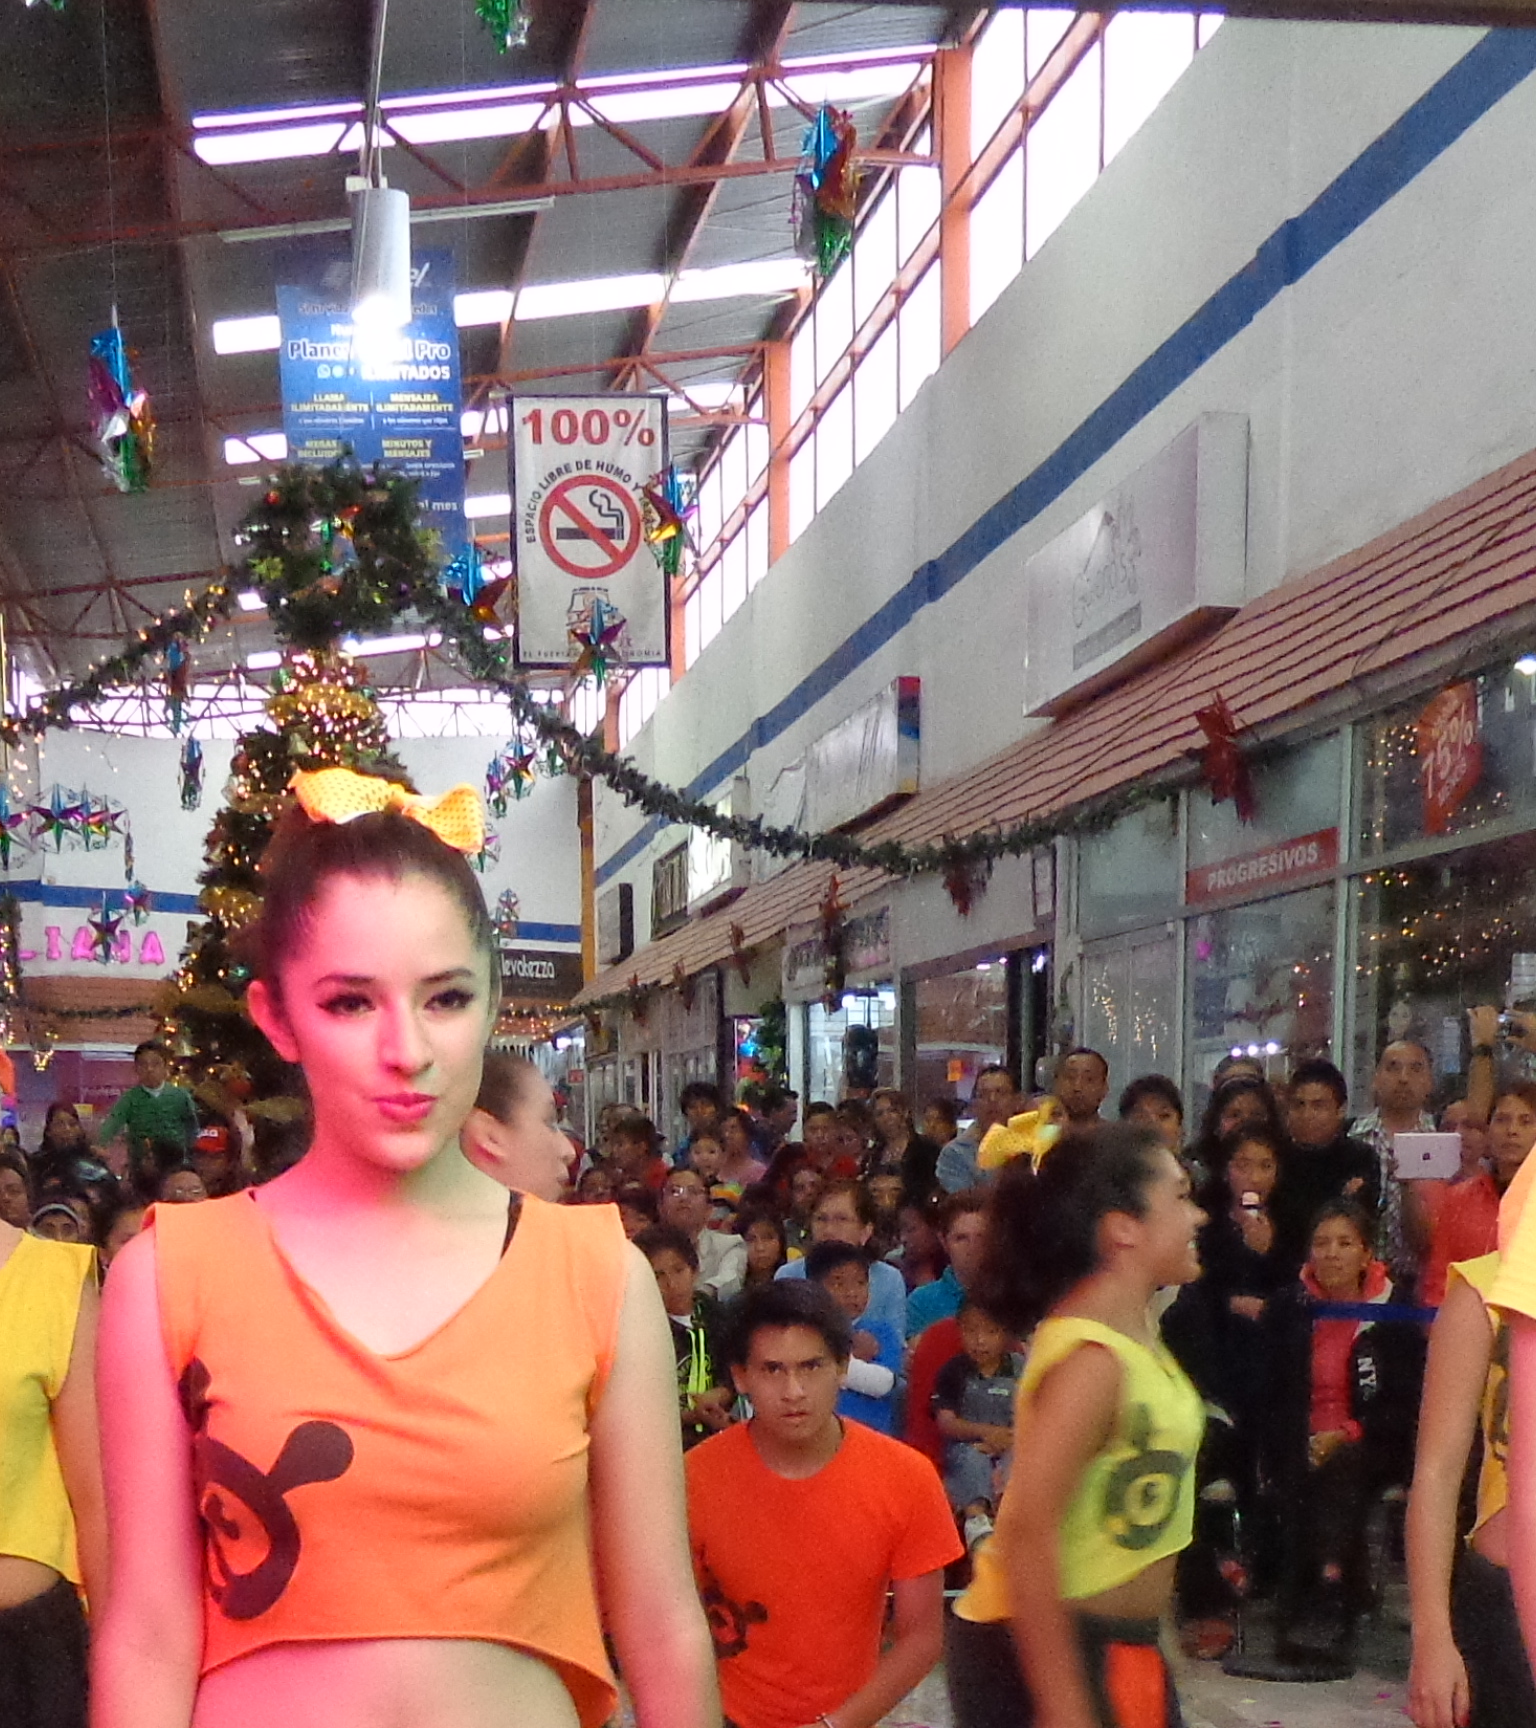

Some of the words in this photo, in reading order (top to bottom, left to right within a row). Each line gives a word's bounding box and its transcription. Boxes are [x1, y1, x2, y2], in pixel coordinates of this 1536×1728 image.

[415, 340, 451, 360] Pro
[522, 408, 655, 446] 100%
[525, 490, 542, 543] ESPACIO
[538, 462, 573, 491] LIBRE
[575, 459, 592, 471] DE
[596, 460, 632, 483] HUMO
[1207, 842, 1320, 893] PROGRESIVOS
